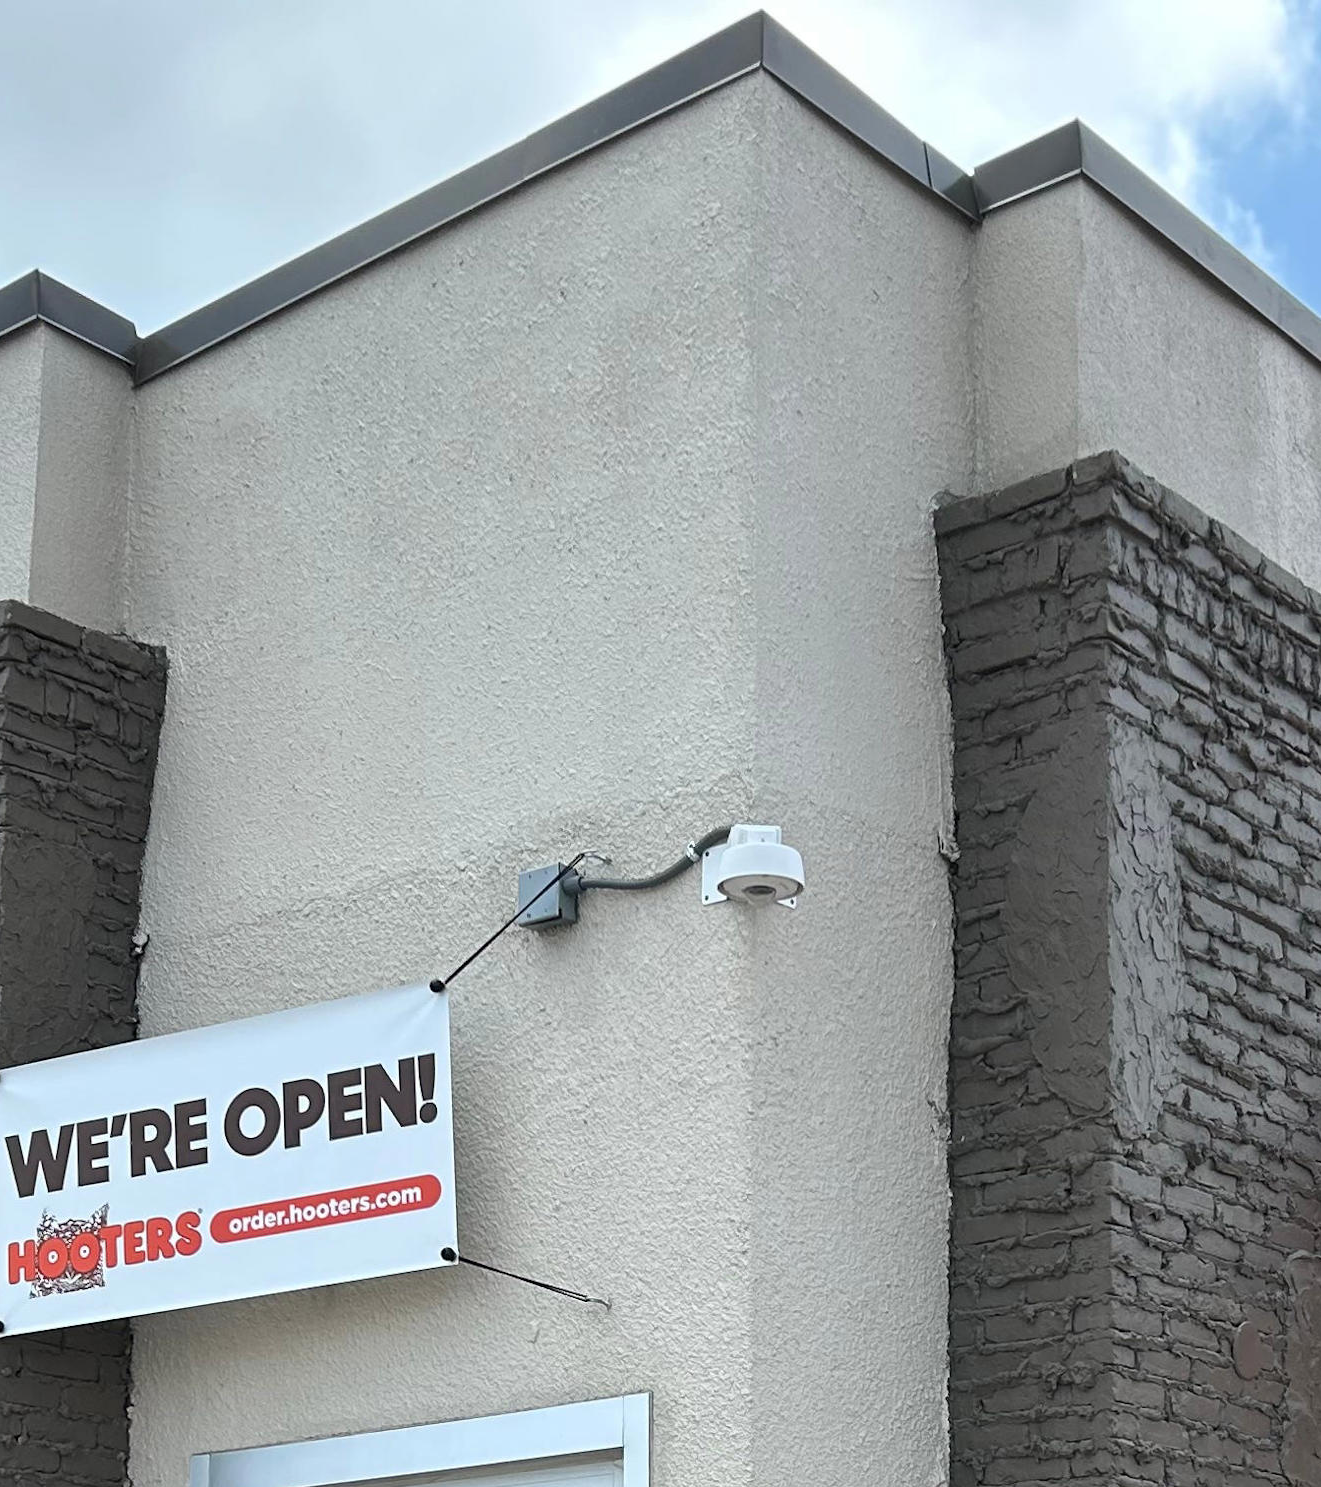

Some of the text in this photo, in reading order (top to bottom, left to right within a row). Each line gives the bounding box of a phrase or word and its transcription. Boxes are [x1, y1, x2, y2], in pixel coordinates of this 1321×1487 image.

[5, 1052, 439, 1198] WE'RE OPEN!
[229, 1184, 423, 1234] order.hooters.com
[8, 1211, 203, 1285] HOOTERS
